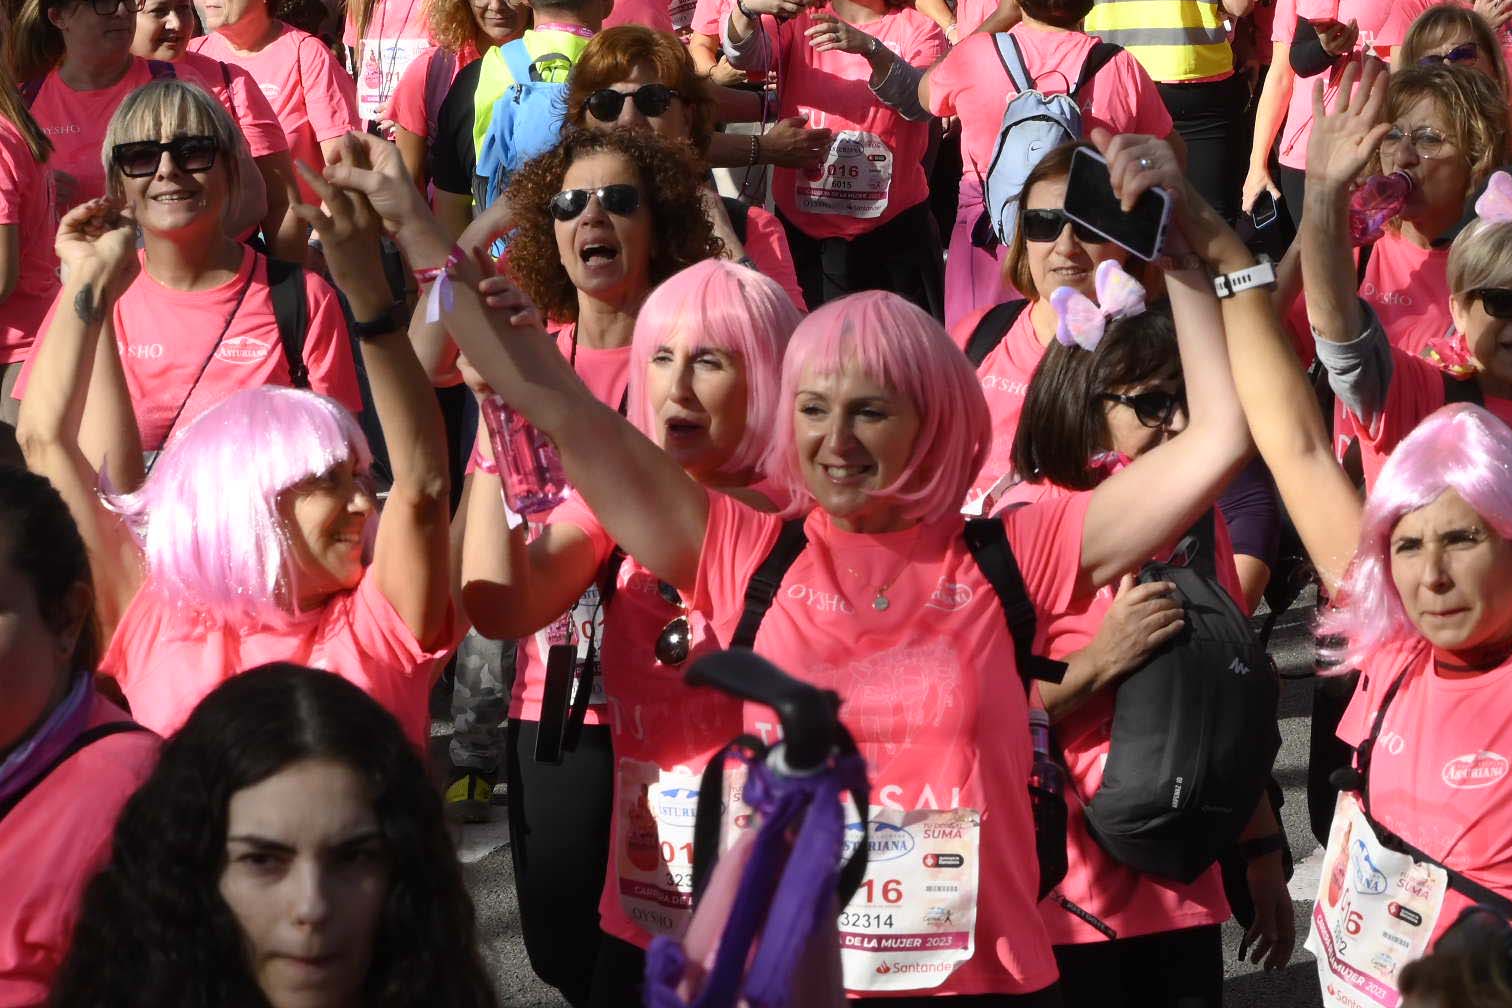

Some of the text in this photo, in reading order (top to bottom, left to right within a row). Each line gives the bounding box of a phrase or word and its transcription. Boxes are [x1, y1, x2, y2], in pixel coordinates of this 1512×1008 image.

[827, 164, 859, 178] 016
[1363, 283, 1412, 306] OSHO
[923, 829, 963, 840] SUMA
[842, 838, 909, 853] STRIANA
[1397, 879, 1431, 901] SUMA
[632, 906, 673, 929] OYSHO
[840, 911, 895, 929] 32314
[845, 935, 953, 949] DE LA MUJER 2023
[892, 961, 957, 974] Santande
[1333, 957, 1387, 999] MUJER 2023
